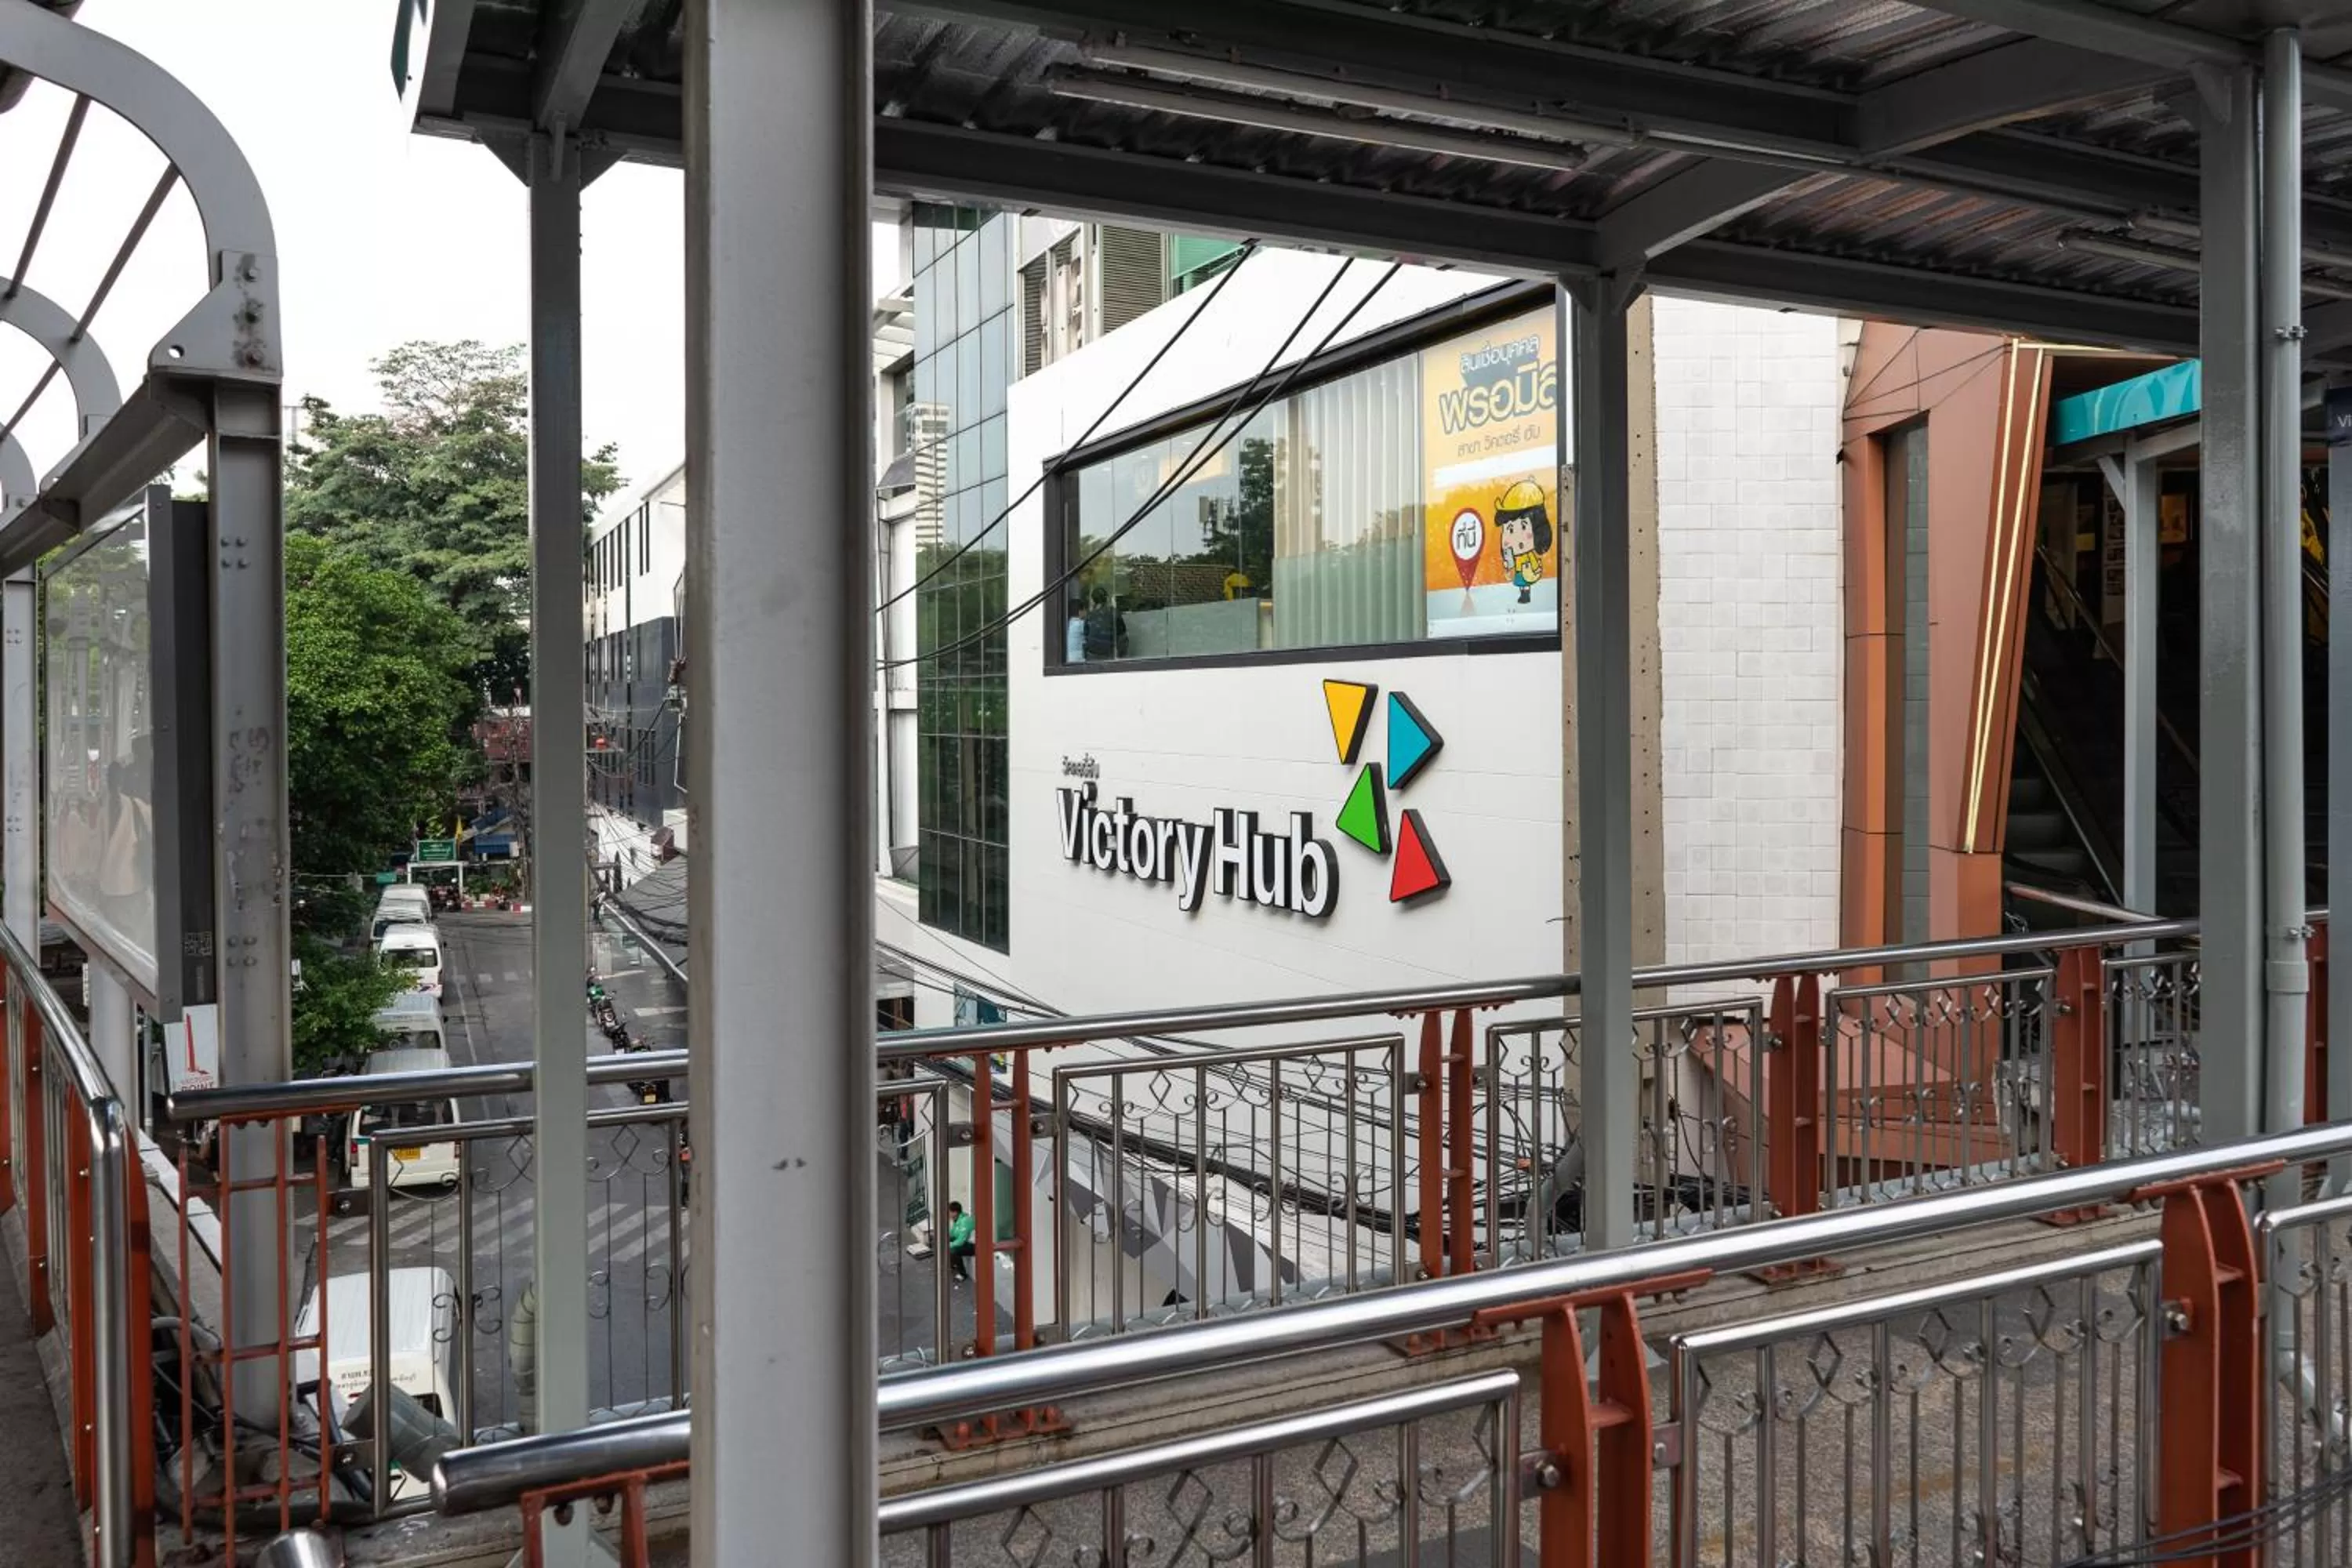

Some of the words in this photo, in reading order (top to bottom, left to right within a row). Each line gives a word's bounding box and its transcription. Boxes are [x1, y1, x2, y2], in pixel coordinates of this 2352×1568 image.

[1456, 521, 1476, 550] ที่นี่
[1057, 782, 1339, 917] VictoryHub
